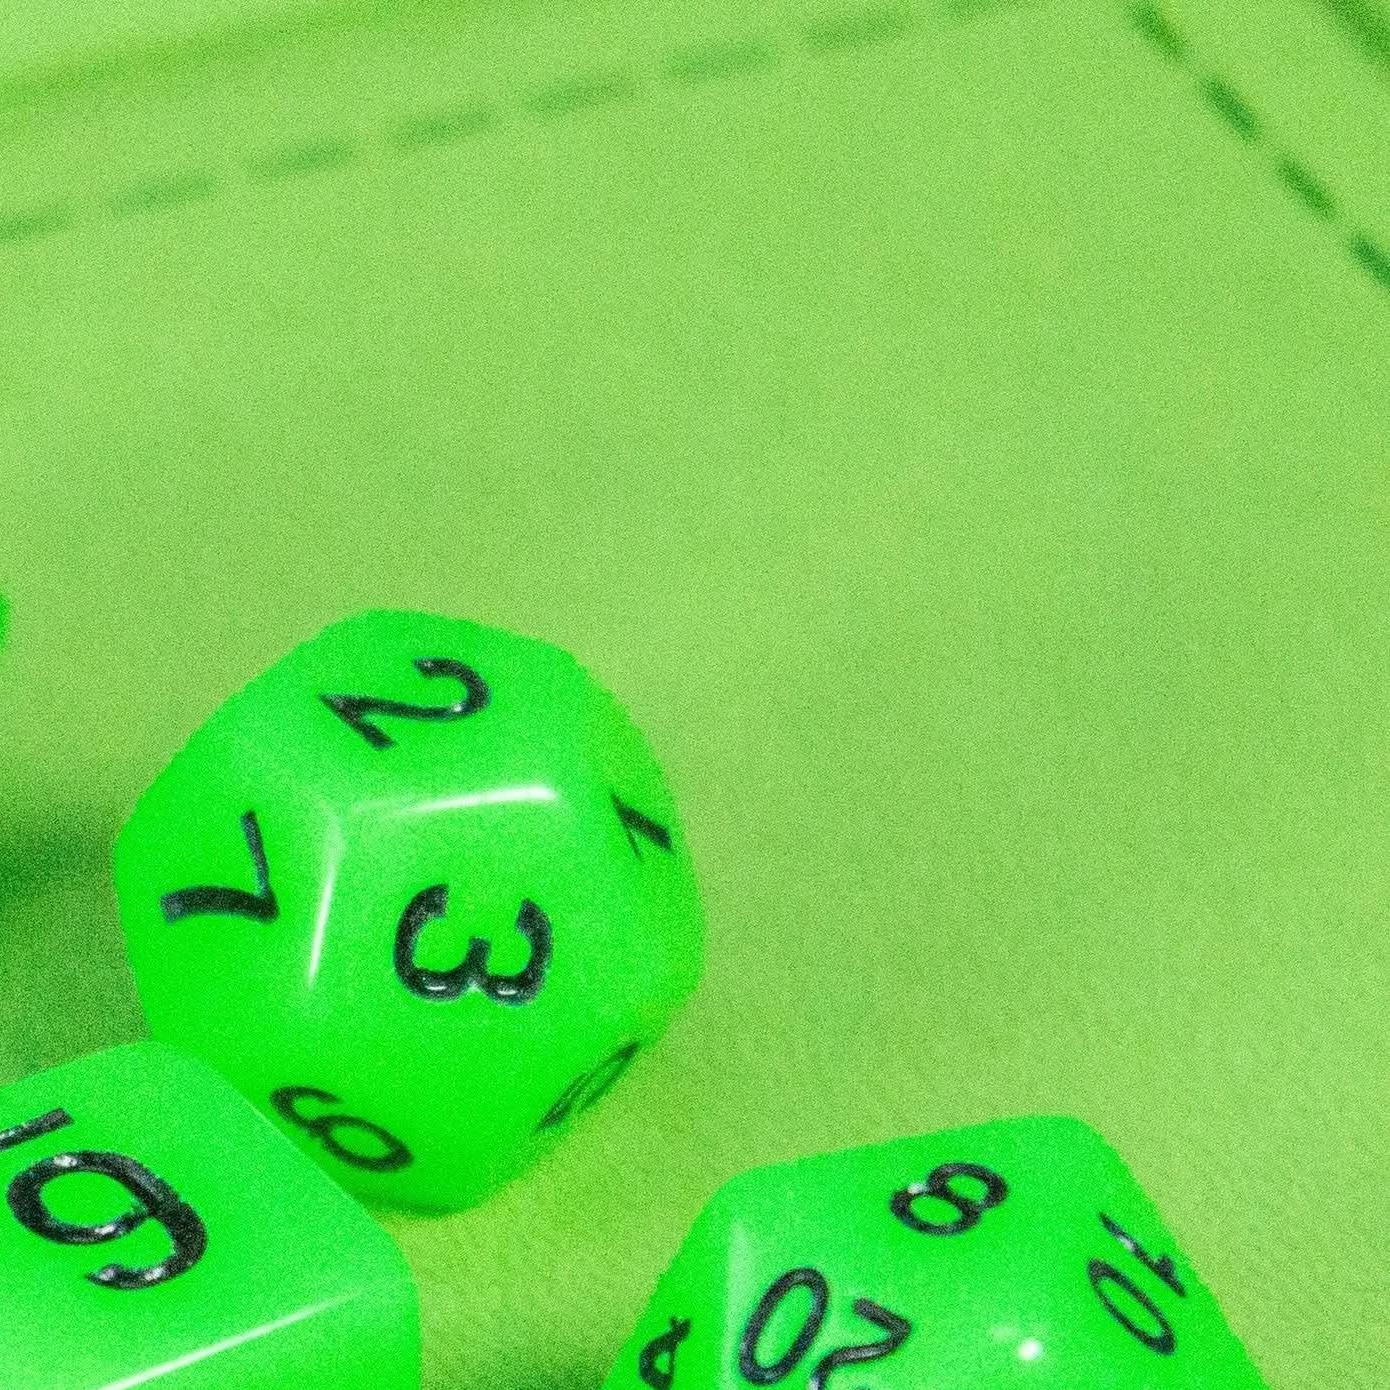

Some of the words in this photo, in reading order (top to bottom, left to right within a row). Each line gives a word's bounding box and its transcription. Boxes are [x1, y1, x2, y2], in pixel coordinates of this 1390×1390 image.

[321, 657, 490, 749] 2
[161, 811, 279, 922] 7
[393, 884, 552, 1004] 3
[889, 1162, 1009, 1236] 8
[1087, 1214, 1186, 1356] 10
